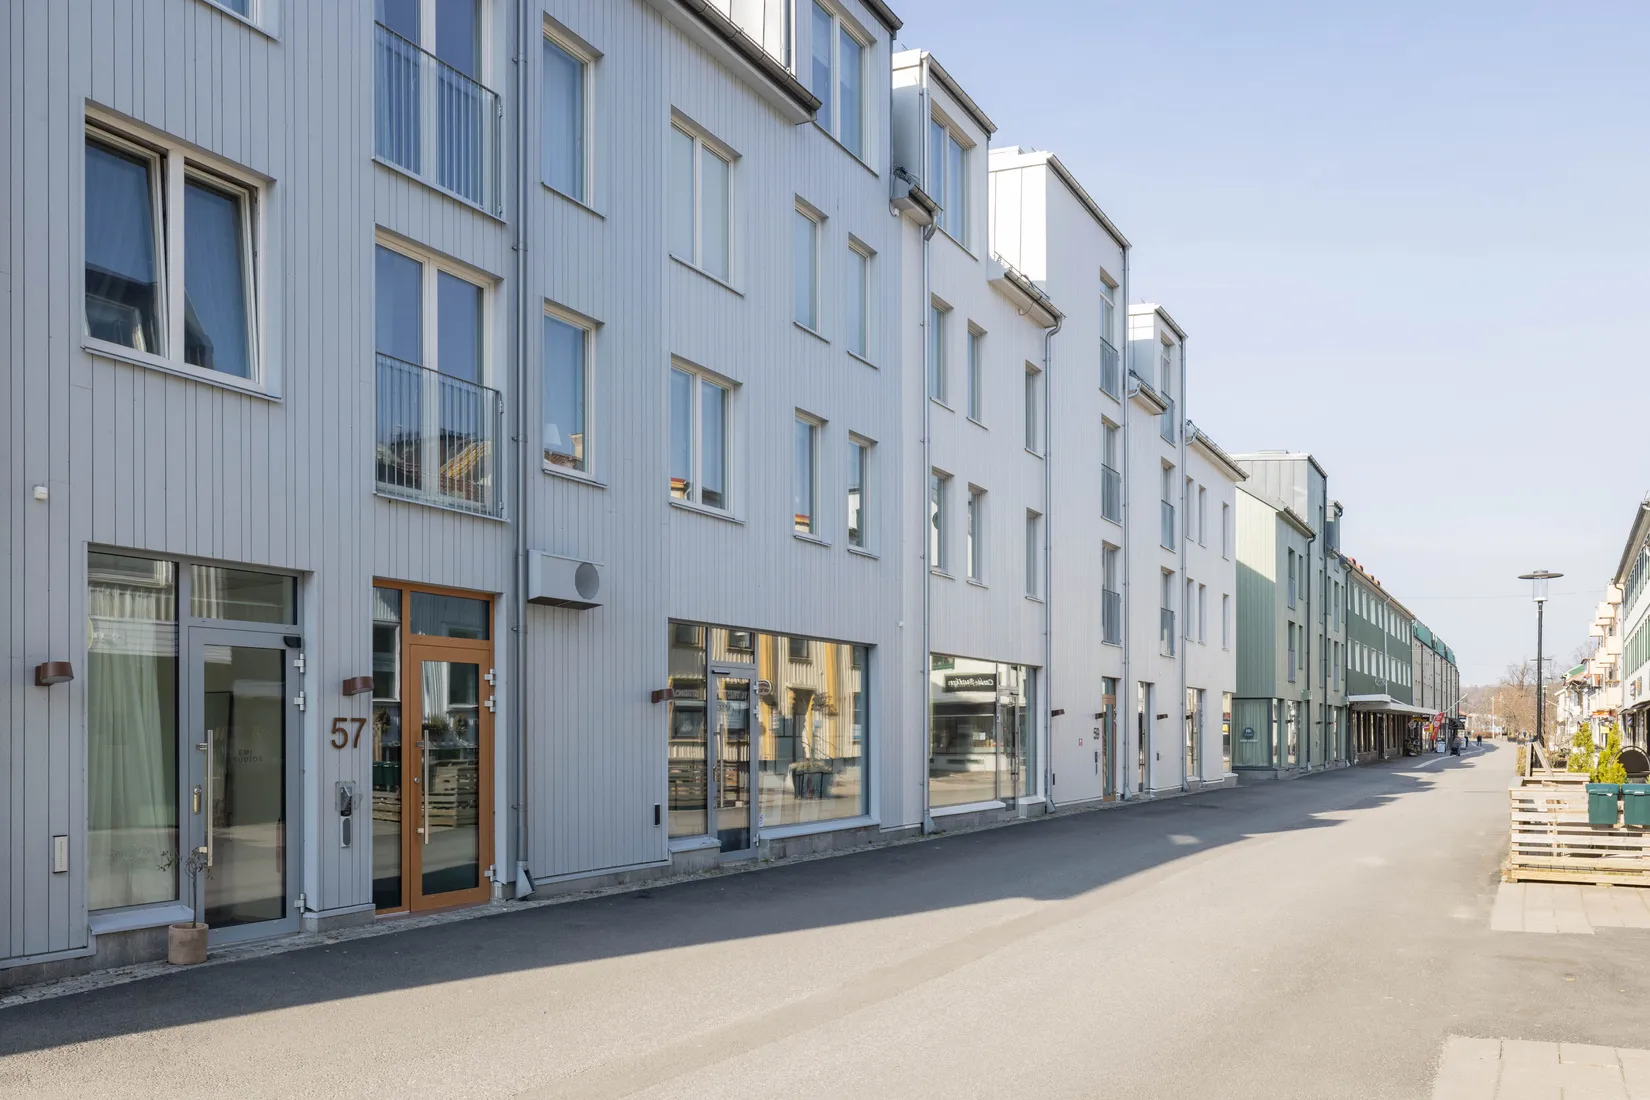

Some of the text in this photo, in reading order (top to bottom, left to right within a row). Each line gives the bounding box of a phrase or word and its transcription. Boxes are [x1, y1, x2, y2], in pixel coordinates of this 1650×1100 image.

[331, 717, 367, 750] 57
[1093, 727, 1100, 740] 59
[229, 755, 263, 763] TUDIOS
